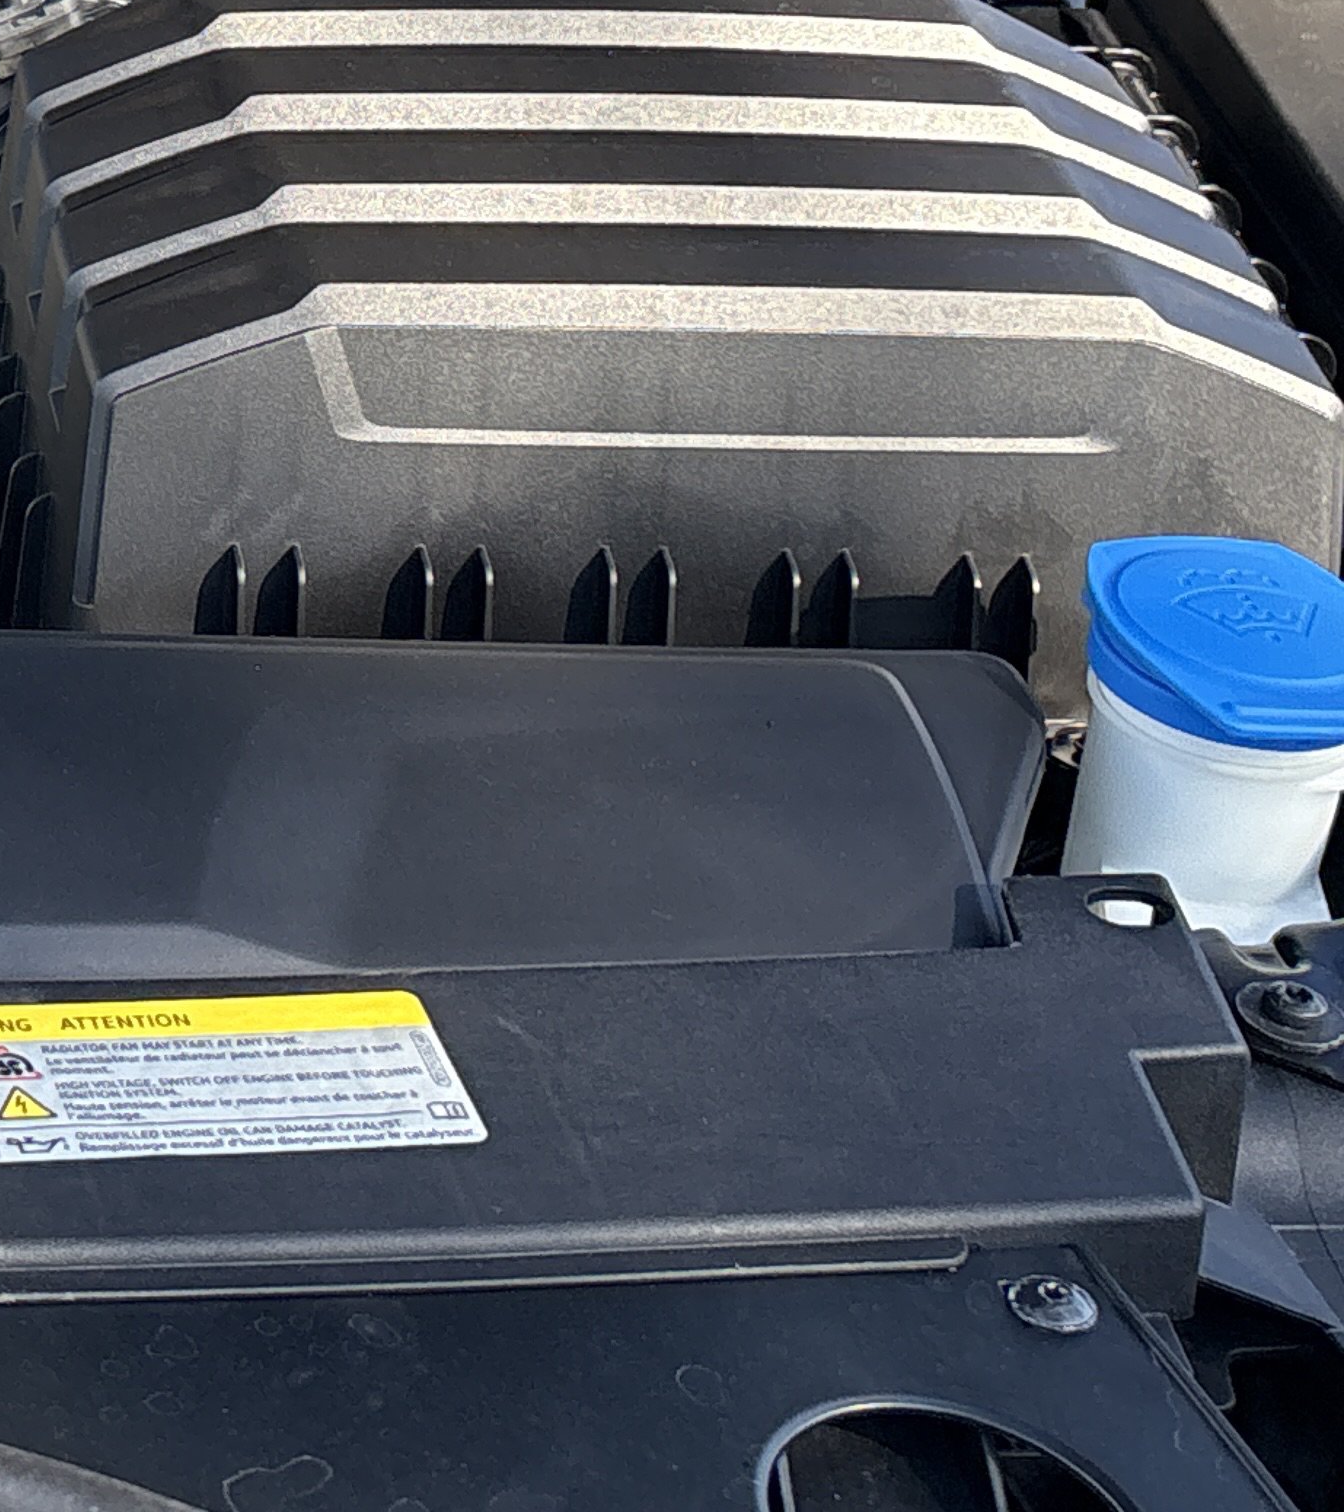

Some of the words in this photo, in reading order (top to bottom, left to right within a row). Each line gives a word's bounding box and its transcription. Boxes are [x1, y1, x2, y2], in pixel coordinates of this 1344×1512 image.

[60, 1013, 192, 1031] ATTENTION
[40, 1041, 109, 1054] RADIATOR
[112, 1041, 139, 1052] FAN
[141, 1040, 170, 1050] MAY
[172, 1039, 213, 1049] START
[216, 1038, 234, 1048] AT
[236, 1036, 264, 1047] ANY
[144, 1052, 160, 1062] de
[230, 1049, 262, 1061] peut
[54, 1080, 90, 1090] HIGH
[159, 1076, 211, 1087] SWITCH
[214, 1075, 238, 1085] OFF
[243, 1073, 293, 1084] ENGINE
[296, 1070, 350, 1081] BEFORE
[354, 1066, 423, 1079] TOUCHING
[58, 1089, 121, 1099] IGNITION
[353, 1089, 407, 1100] toucher
[75, 1130, 159, 1140] OVERFILLED
[162, 1127, 214, 1138] ENGINE
[242, 1124, 273, 1135] CAN
[275, 1122, 335, 1133] DAMAGE
[353, 1132, 385, 1144] pour
